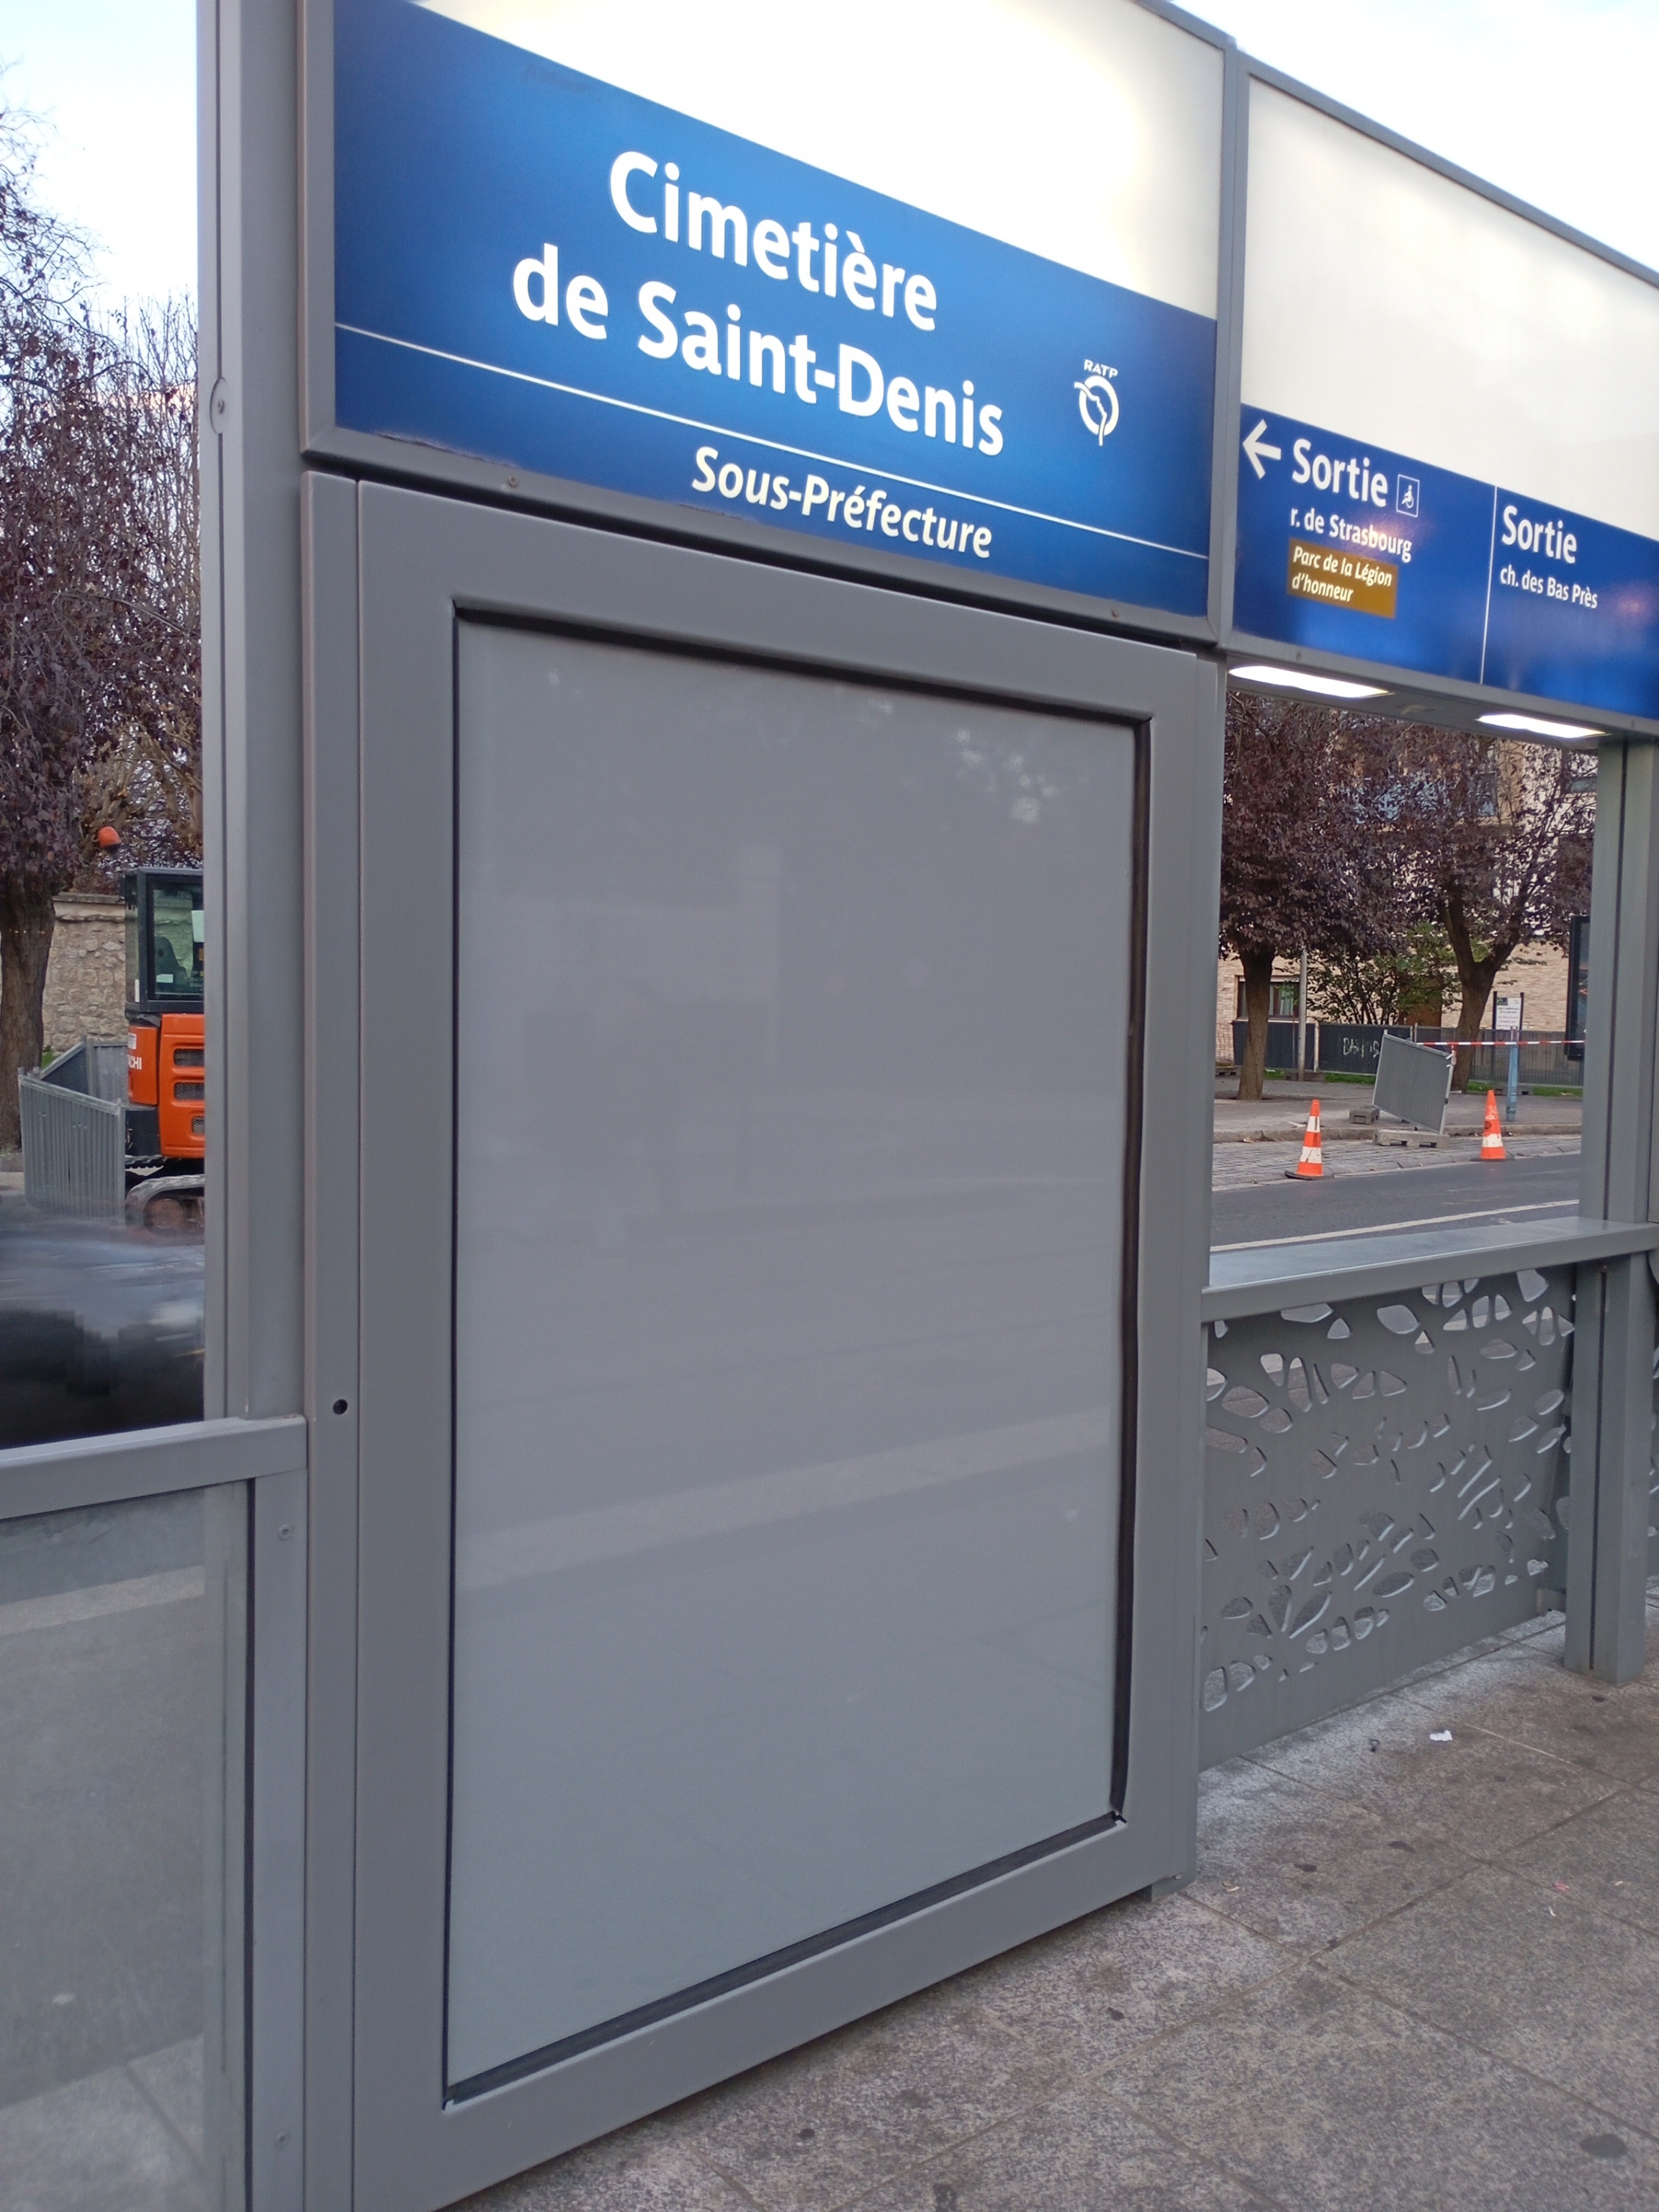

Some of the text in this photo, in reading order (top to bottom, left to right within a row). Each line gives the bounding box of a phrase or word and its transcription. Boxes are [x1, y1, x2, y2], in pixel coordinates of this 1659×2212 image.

[609, 150, 938, 331] Cimetière
[512, 243, 1004, 456] de Saint-Denis
[1084, 359, 1118, 378] RATP
[1292, 439, 1388, 507] Sortie
[691, 446, 993, 558] Sous-Préfecture
[1290, 507, 1412, 563] r. de Strasbourg
[1501, 505, 1577, 563] Sortie
[1292, 572, 1354, 602] d'honneur
[1293, 546, 1393, 587] Parc de la Légion
[1500, 564, 1599, 608] ch. des Bas Près
